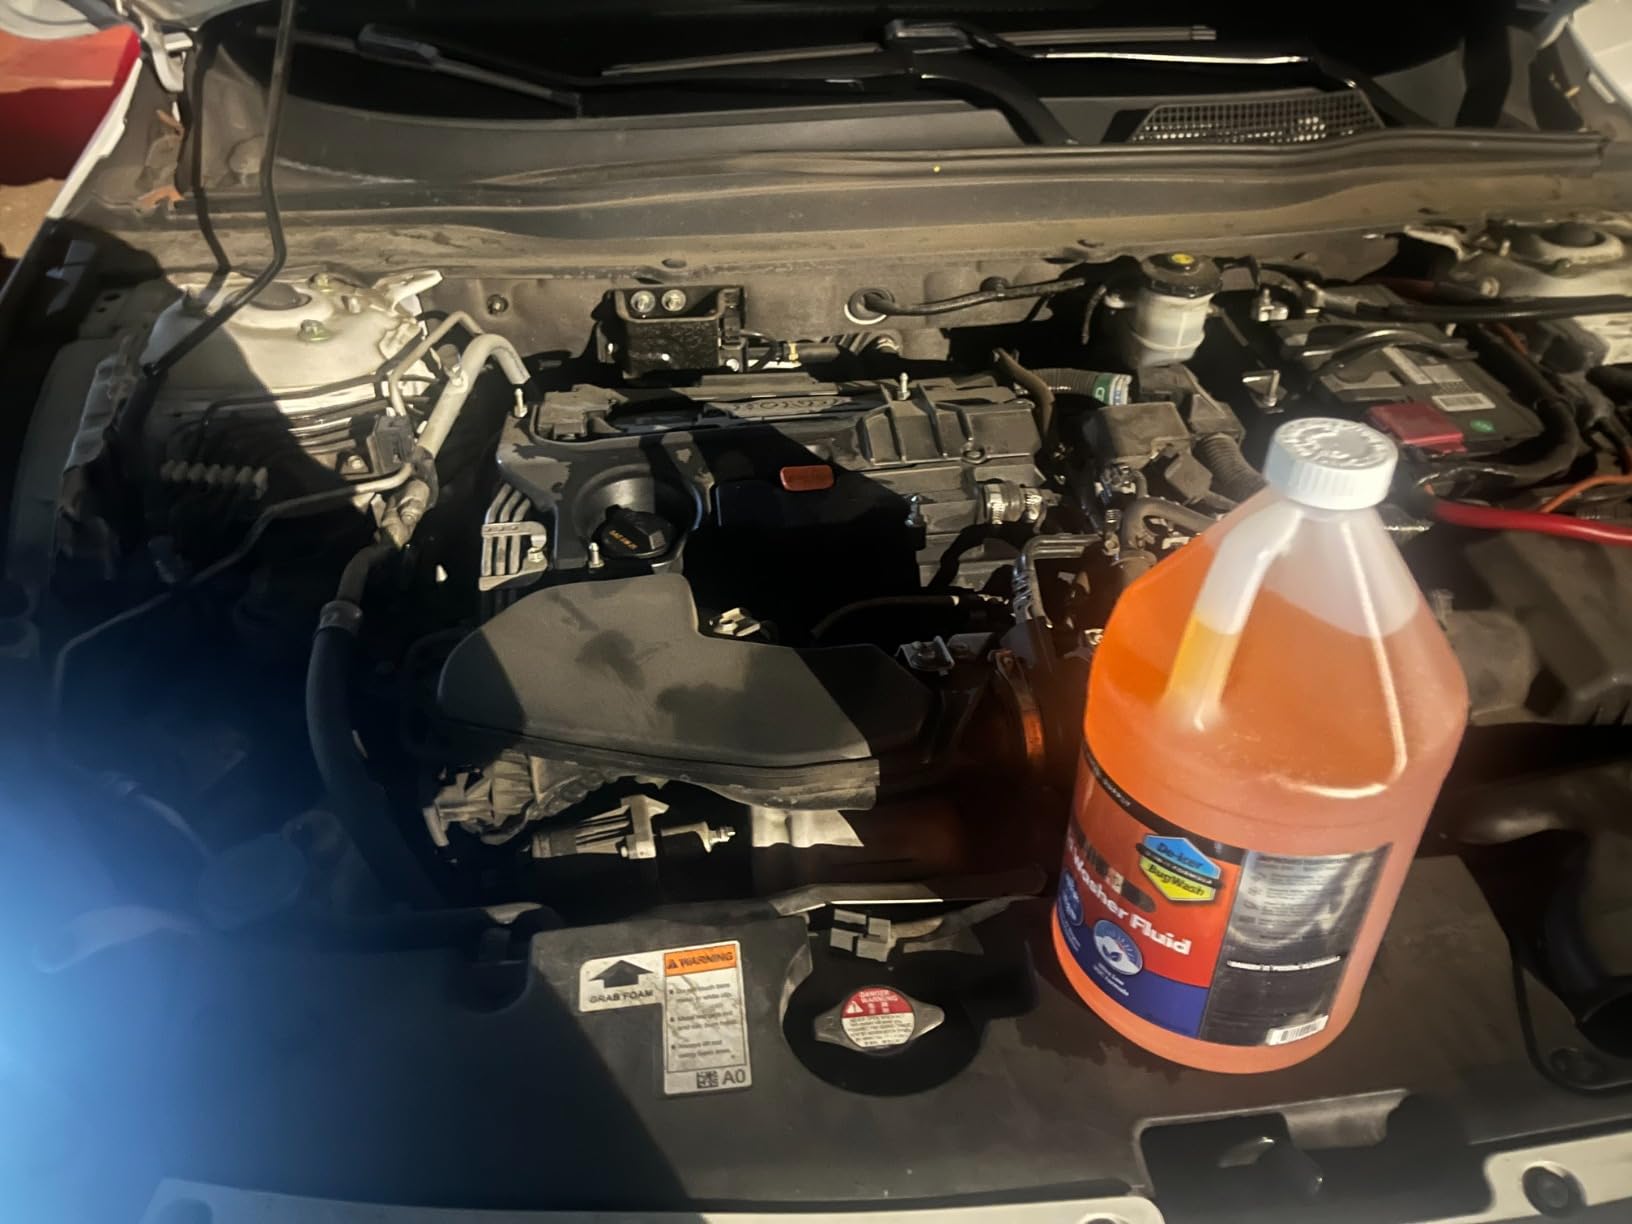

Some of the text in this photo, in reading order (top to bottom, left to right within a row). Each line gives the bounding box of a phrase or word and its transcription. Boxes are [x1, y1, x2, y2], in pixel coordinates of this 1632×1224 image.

[1149, 864, 1205, 896] BugWash
[1073, 849, 1128, 919] Washer
[1130, 914, 1192, 955] Fluid
[680, 951, 734, 967] WARNING
[589, 988, 654, 1003] GRAB FOAM
[722, 1068, 746, 1084] A0
